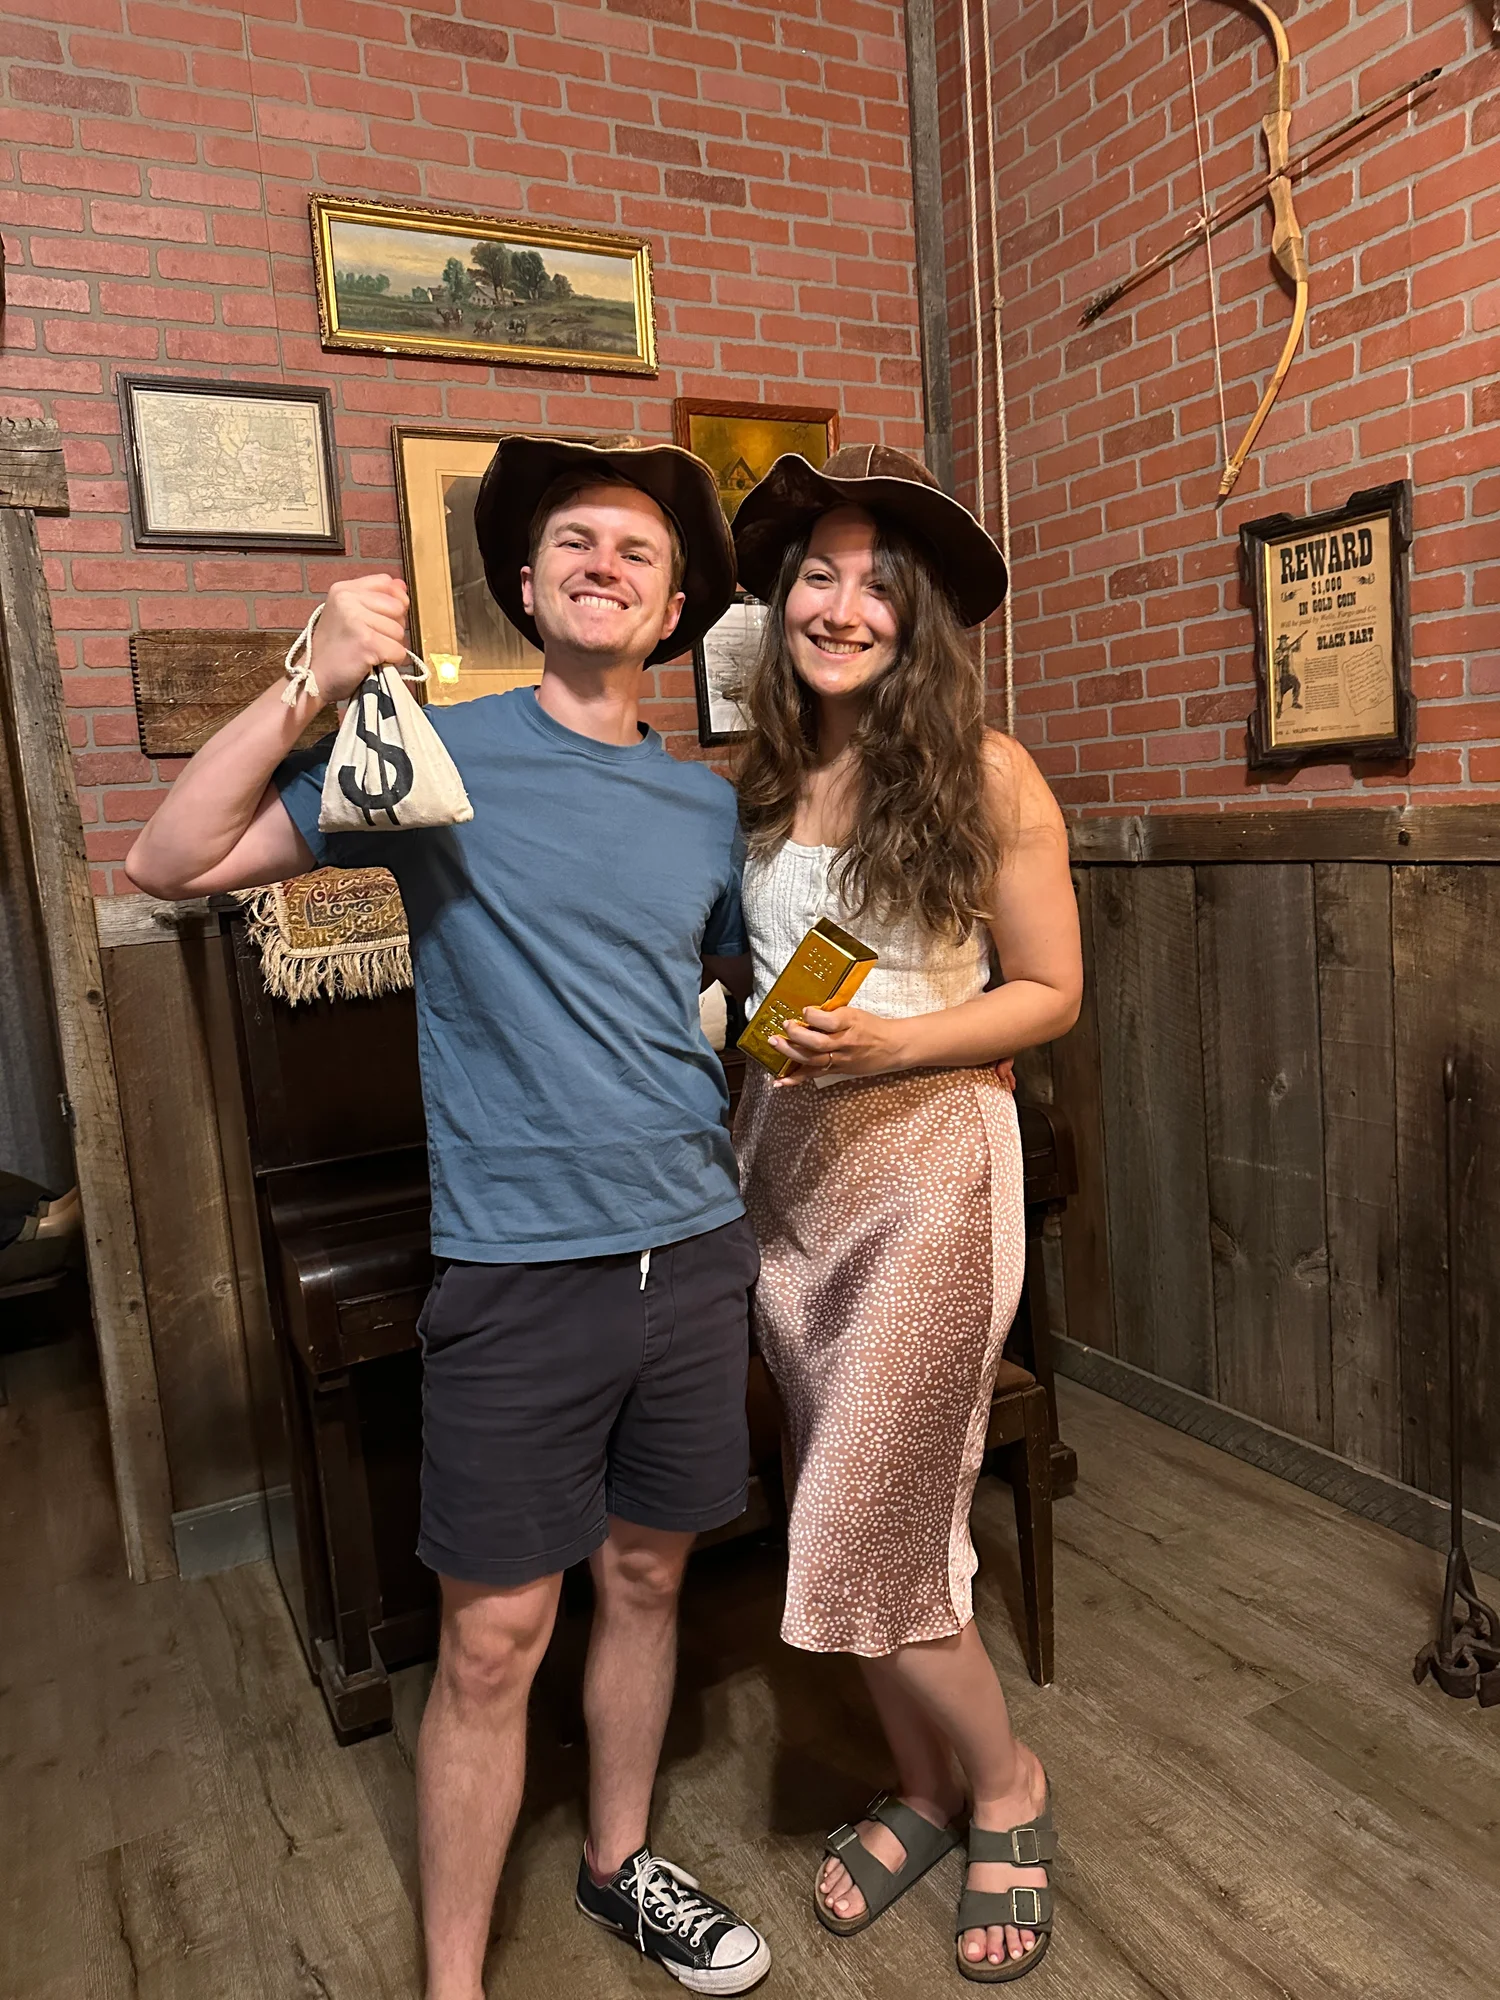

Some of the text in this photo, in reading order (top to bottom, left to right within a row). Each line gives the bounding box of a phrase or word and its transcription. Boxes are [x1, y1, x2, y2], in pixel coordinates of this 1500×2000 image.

[1280, 528, 1373, 585] REWARD
[1311, 576, 1342, 596] $1,000
[1299, 592, 1356, 616] IN GOLD COIN
[1317, 632, 1346, 650] BLACK
[1349, 627, 1374, 645] BART
